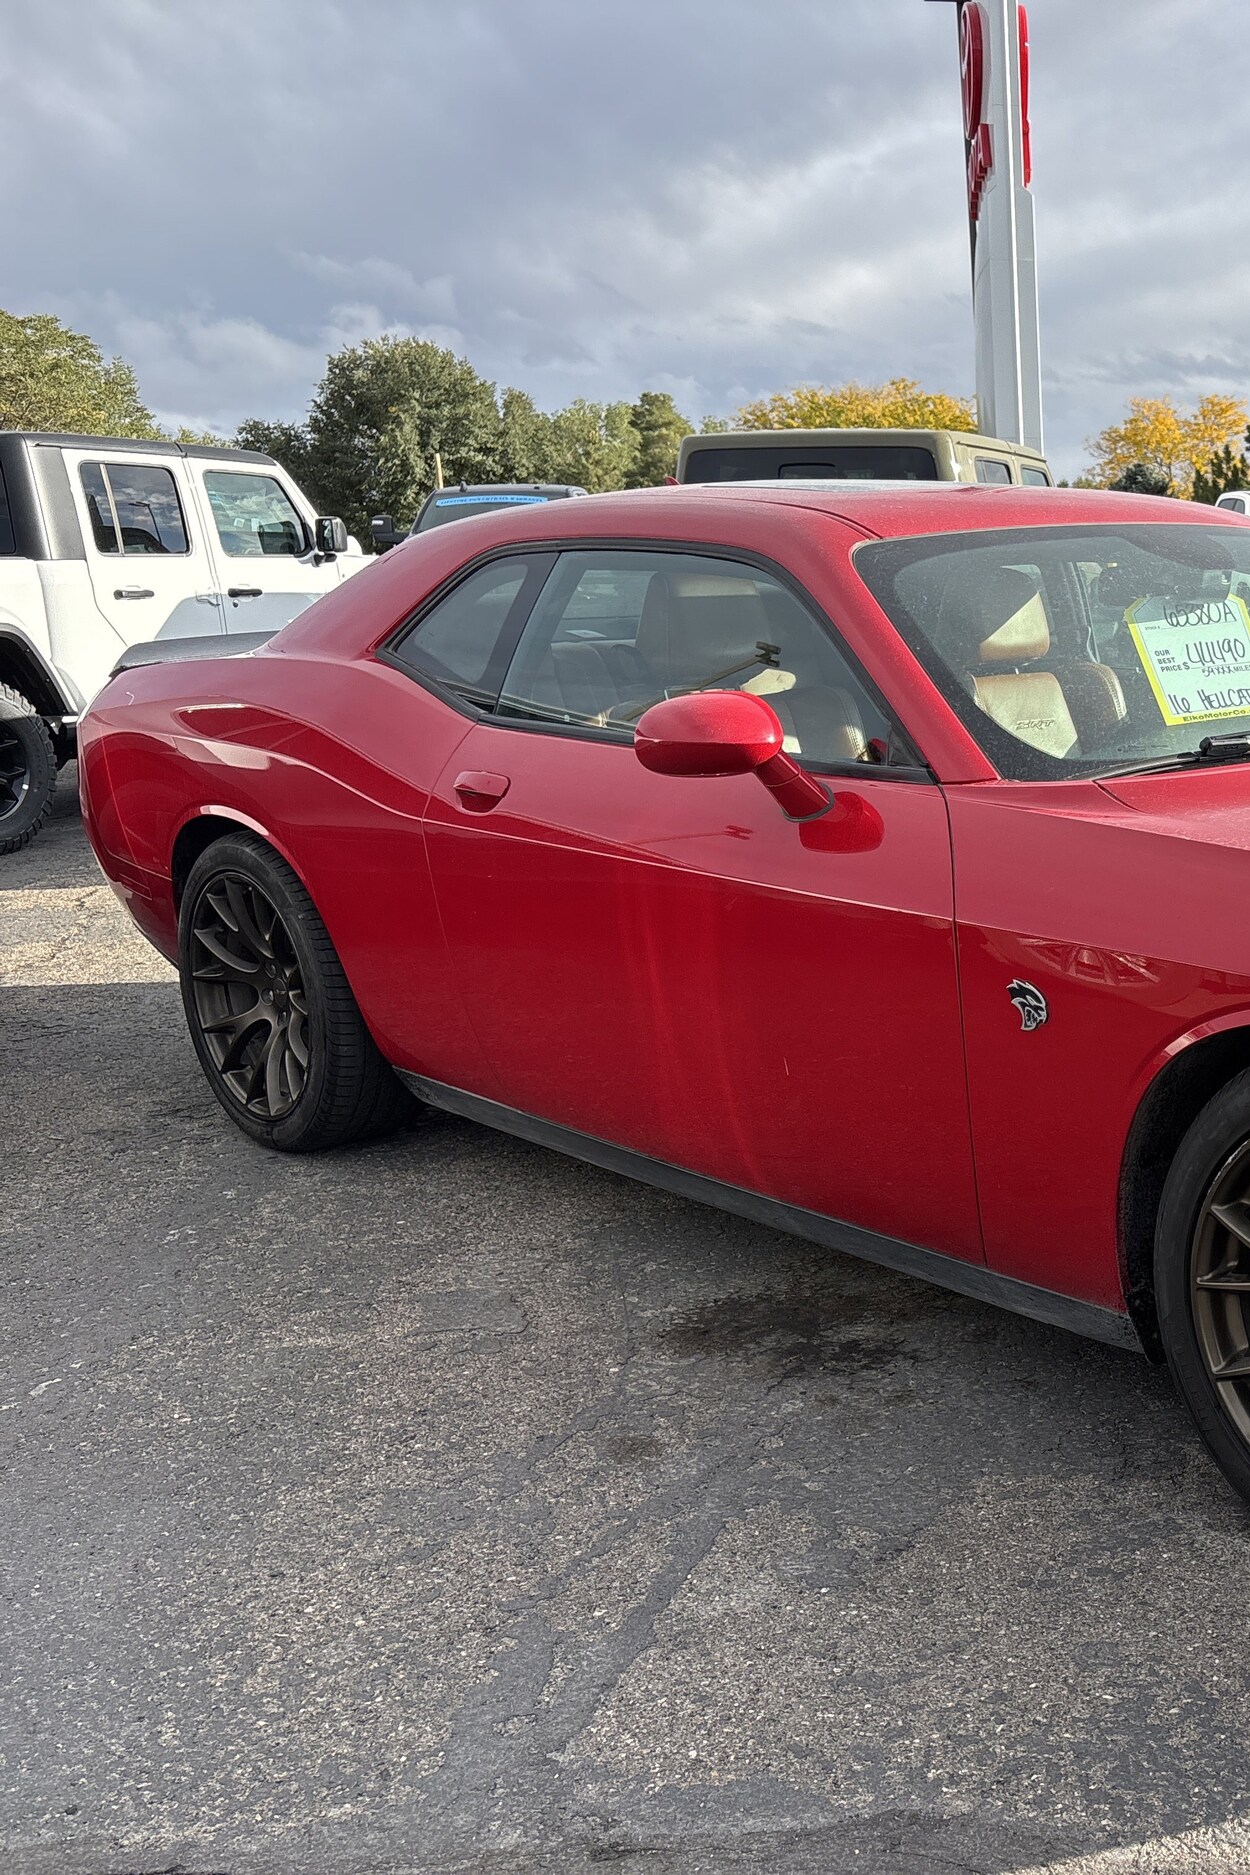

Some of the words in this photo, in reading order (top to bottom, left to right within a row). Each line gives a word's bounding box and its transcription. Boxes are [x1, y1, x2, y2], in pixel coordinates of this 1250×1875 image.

[1154, 649, 1171, 657] OUR
[1160, 664, 1183, 673] PRICE
[1186, 638, 1246, 666] 44490
[1157, 656, 1176, 664] BEST
[1015, 717, 1055, 731] SRT
